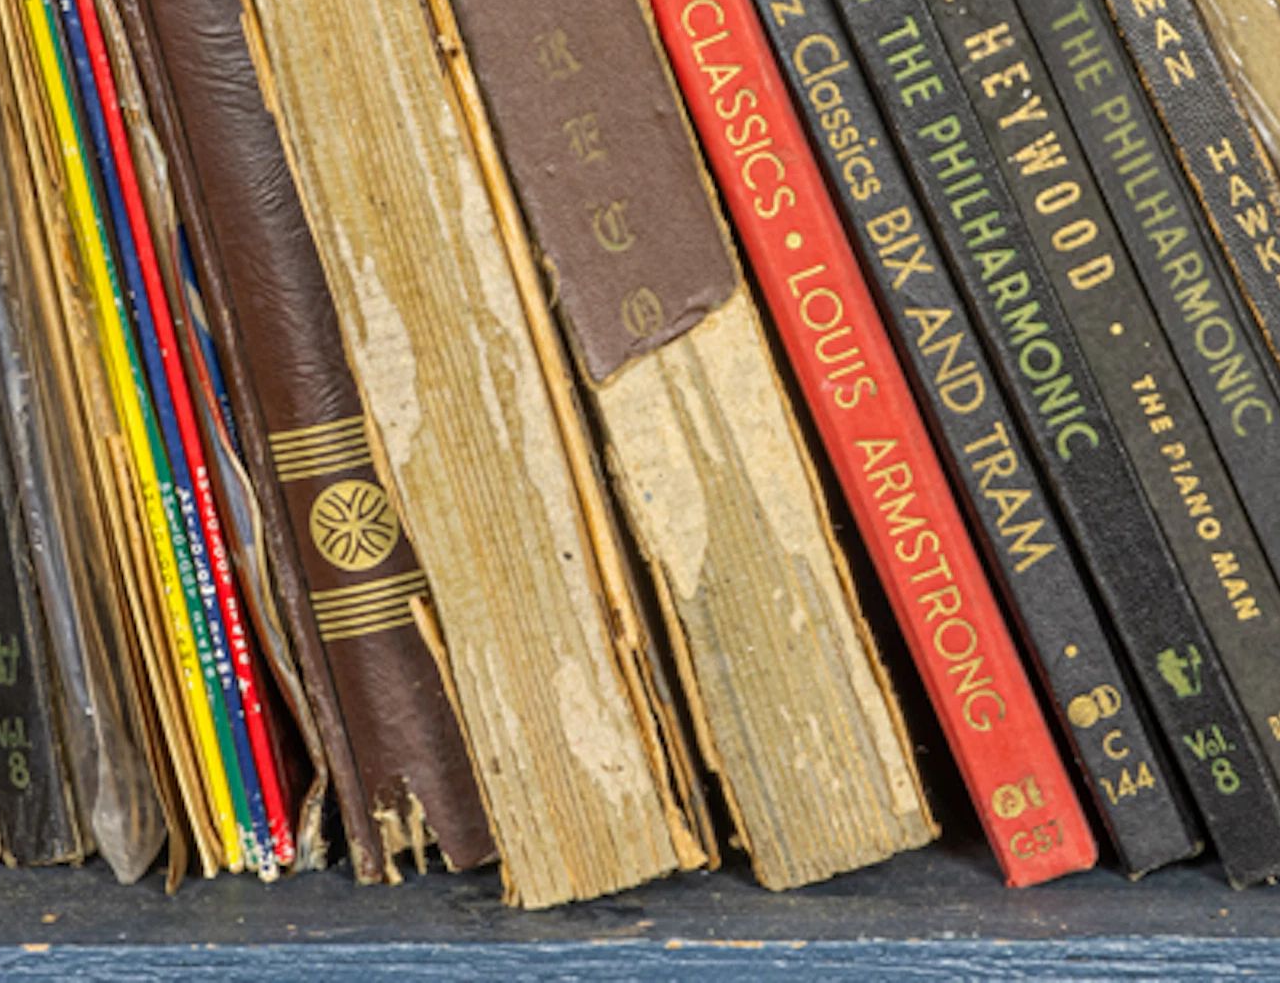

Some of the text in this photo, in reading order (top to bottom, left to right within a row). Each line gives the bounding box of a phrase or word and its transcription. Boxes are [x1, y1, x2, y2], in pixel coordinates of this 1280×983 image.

[793, 34, 881, 200] Classics
[866, 206, 933, 289] BIX
[904, 308, 985, 413] AND
[963, 421, 1055, 572] TRAM
[878, 16, 942, 107] THE
[917, 115, 1098, 459] PHILHARMONIC
[963, 22, 1114, 290] HEYWOOD
[1131, 374, 1173, 433] THE
[1161, 442, 1220, 540] PIANO
[1211, 552, 1259, 620] MAN
[1052, 1, 1113, 91] THE
[1091, 94, 1272, 436] PHILHARMONIC
[786, 264, 876, 409] LOUIS
[854, 439, 1005, 731] ARMSTRONG
[8, 751, 32, 791] 8
[1099, 762, 1155, 804] 144
[1102, 729, 1129, 760] C
[1182, 725, 1235, 763] Vol.
[1211, 758, 1240, 794] 8
